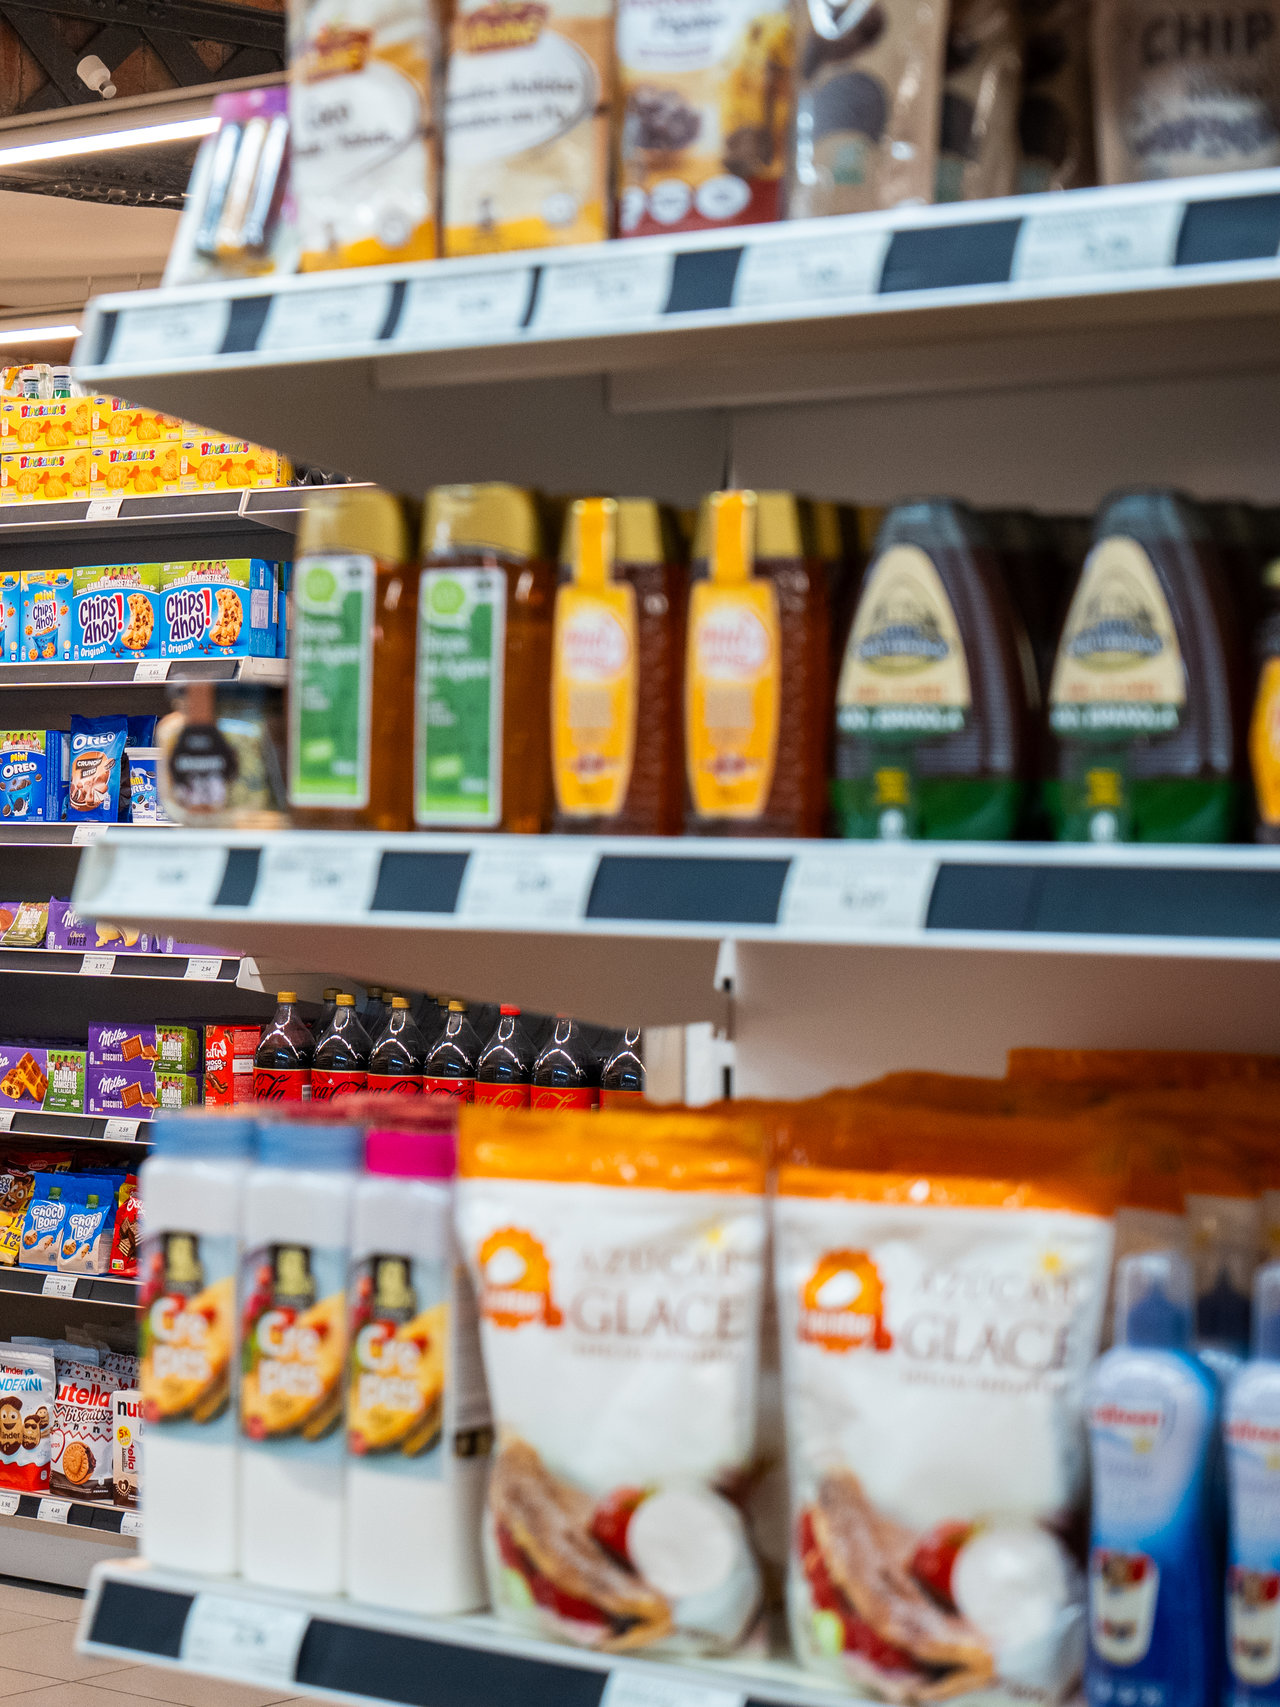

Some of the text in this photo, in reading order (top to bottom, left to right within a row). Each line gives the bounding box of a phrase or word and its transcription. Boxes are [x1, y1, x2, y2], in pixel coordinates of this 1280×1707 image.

[80, 645, 107, 658] Original
[168, 641, 195, 655] Original
[72, 732, 116, 750] OREO
[3, 762, 37, 777] OREO
[98, 1028, 128, 1047] Milka
[98, 1076, 127, 1094] Milka
[569, 1287, 745, 1341] GLACE
[901, 1314, 1075, 1372] GLACE
[0, 1364, 23, 1376] Kinder
[57, 1381, 111, 1407] utella
